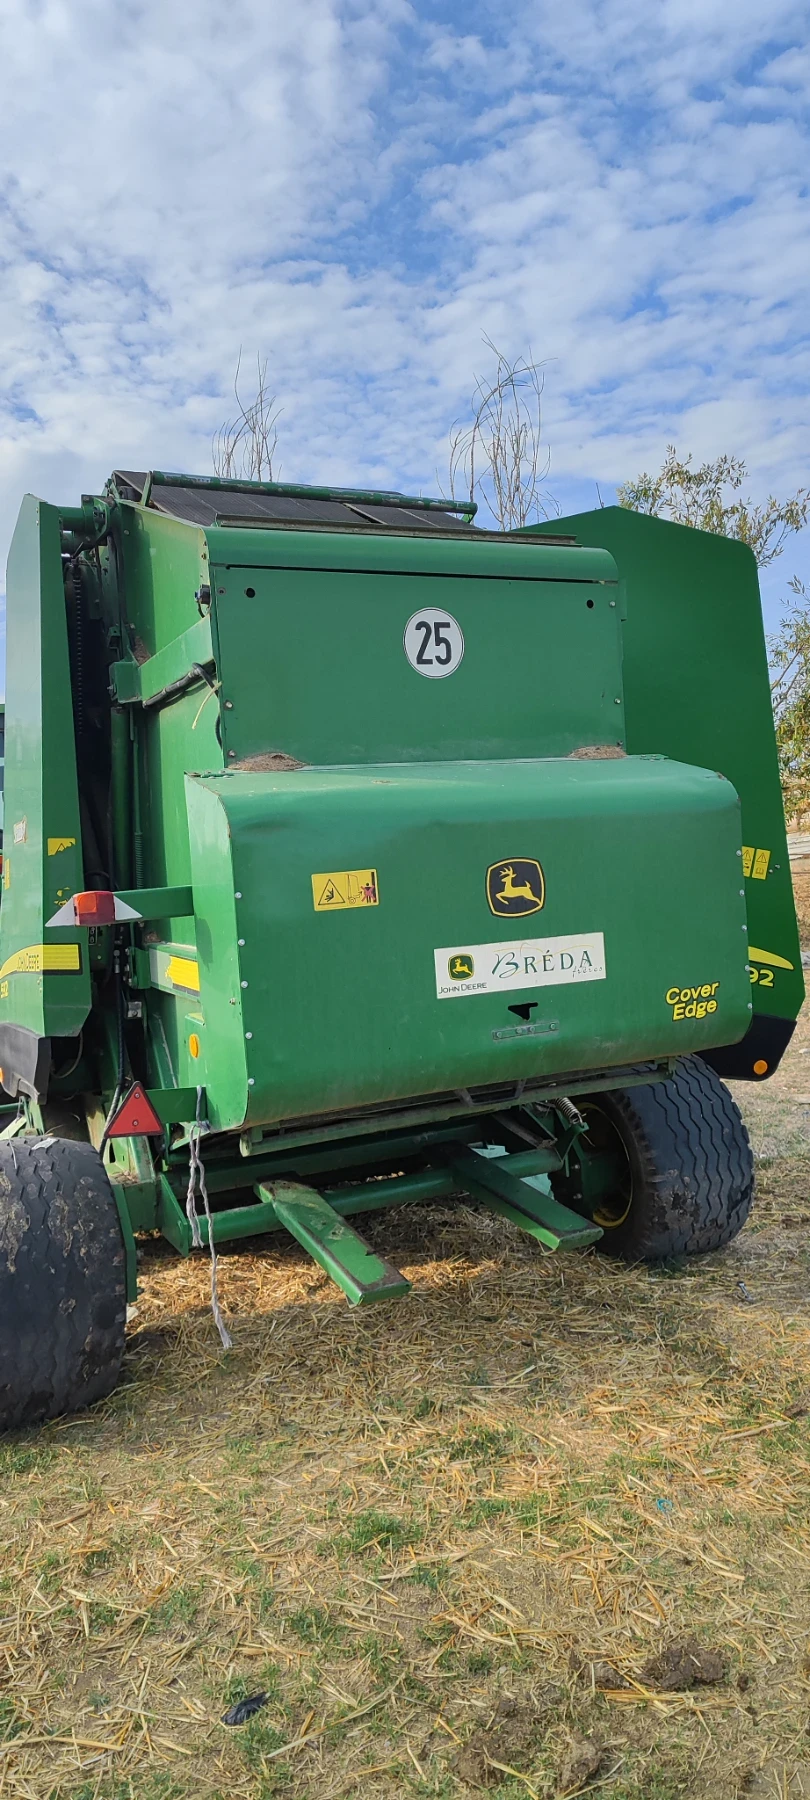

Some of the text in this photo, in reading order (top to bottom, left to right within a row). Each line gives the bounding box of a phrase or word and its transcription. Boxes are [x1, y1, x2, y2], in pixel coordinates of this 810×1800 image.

[415, 621, 452, 665] 25
[491, 950, 593, 978] BRÉDA
[438, 982, 487, 994] JOHN DEERE
[666, 982, 719, 1004] Cover
[673, 1000, 717, 1020] Edge
